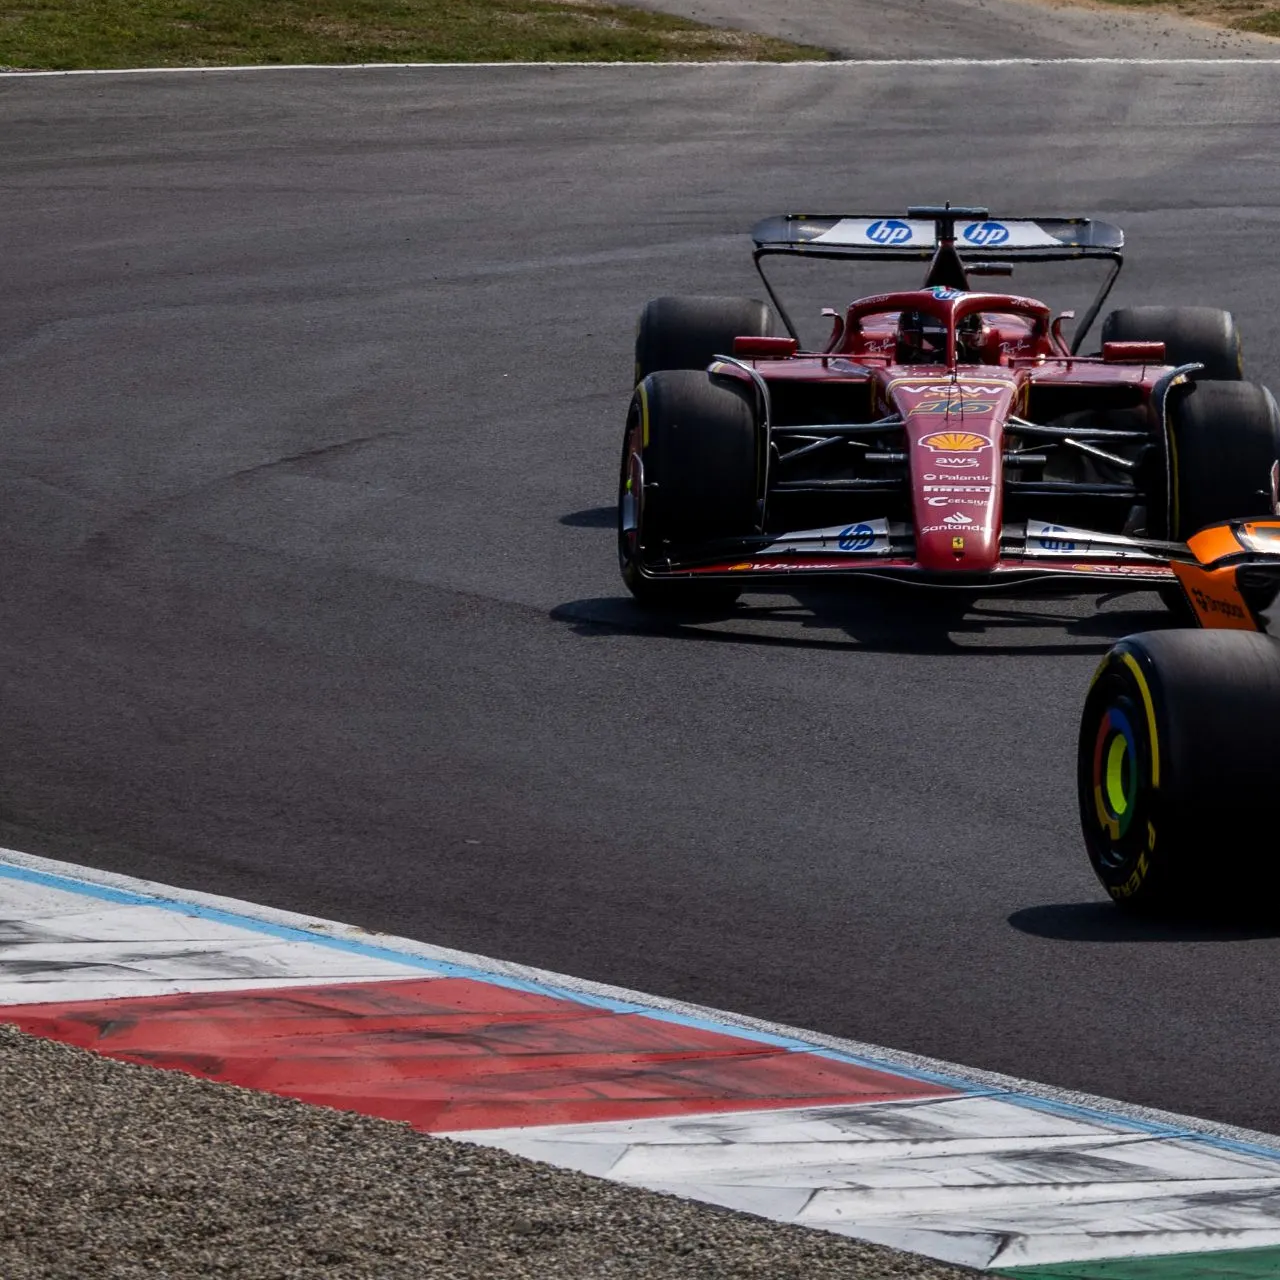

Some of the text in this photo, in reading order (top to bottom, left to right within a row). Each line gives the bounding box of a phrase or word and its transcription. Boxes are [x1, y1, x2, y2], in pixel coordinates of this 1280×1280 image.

[869, 221, 910, 244] hp
[966, 222, 1006, 245] hp
[900, 385, 1004, 395] VGW
[935, 457, 979, 466] aws
[923, 485, 992, 493] PIRELLI
